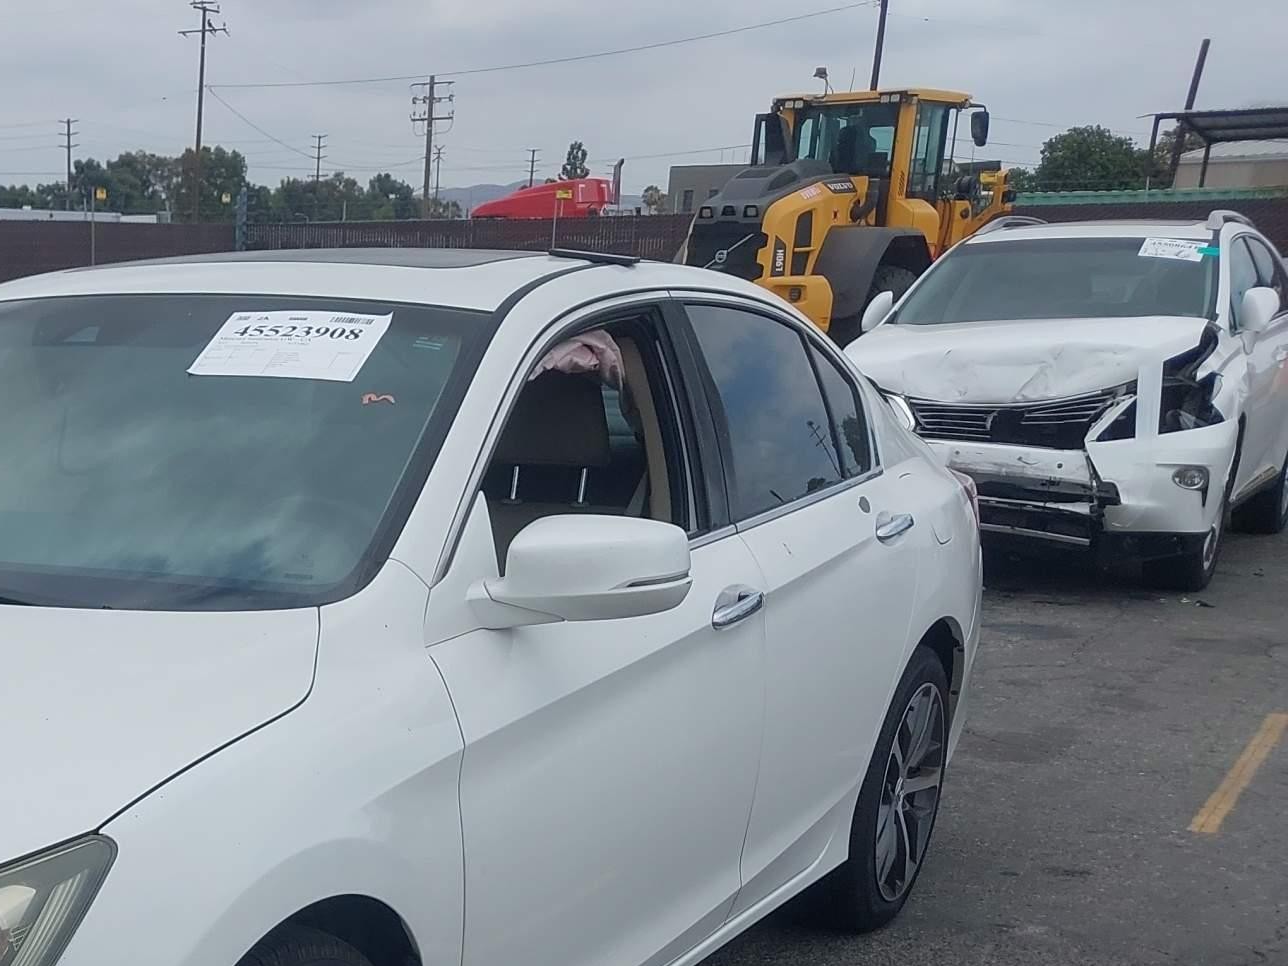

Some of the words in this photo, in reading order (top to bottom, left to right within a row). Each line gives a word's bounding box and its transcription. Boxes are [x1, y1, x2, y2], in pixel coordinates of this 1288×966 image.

[828, 182, 854, 190] VOLVO
[775, 249, 785, 272] L90H
[233, 324, 364, 341] 45523908
